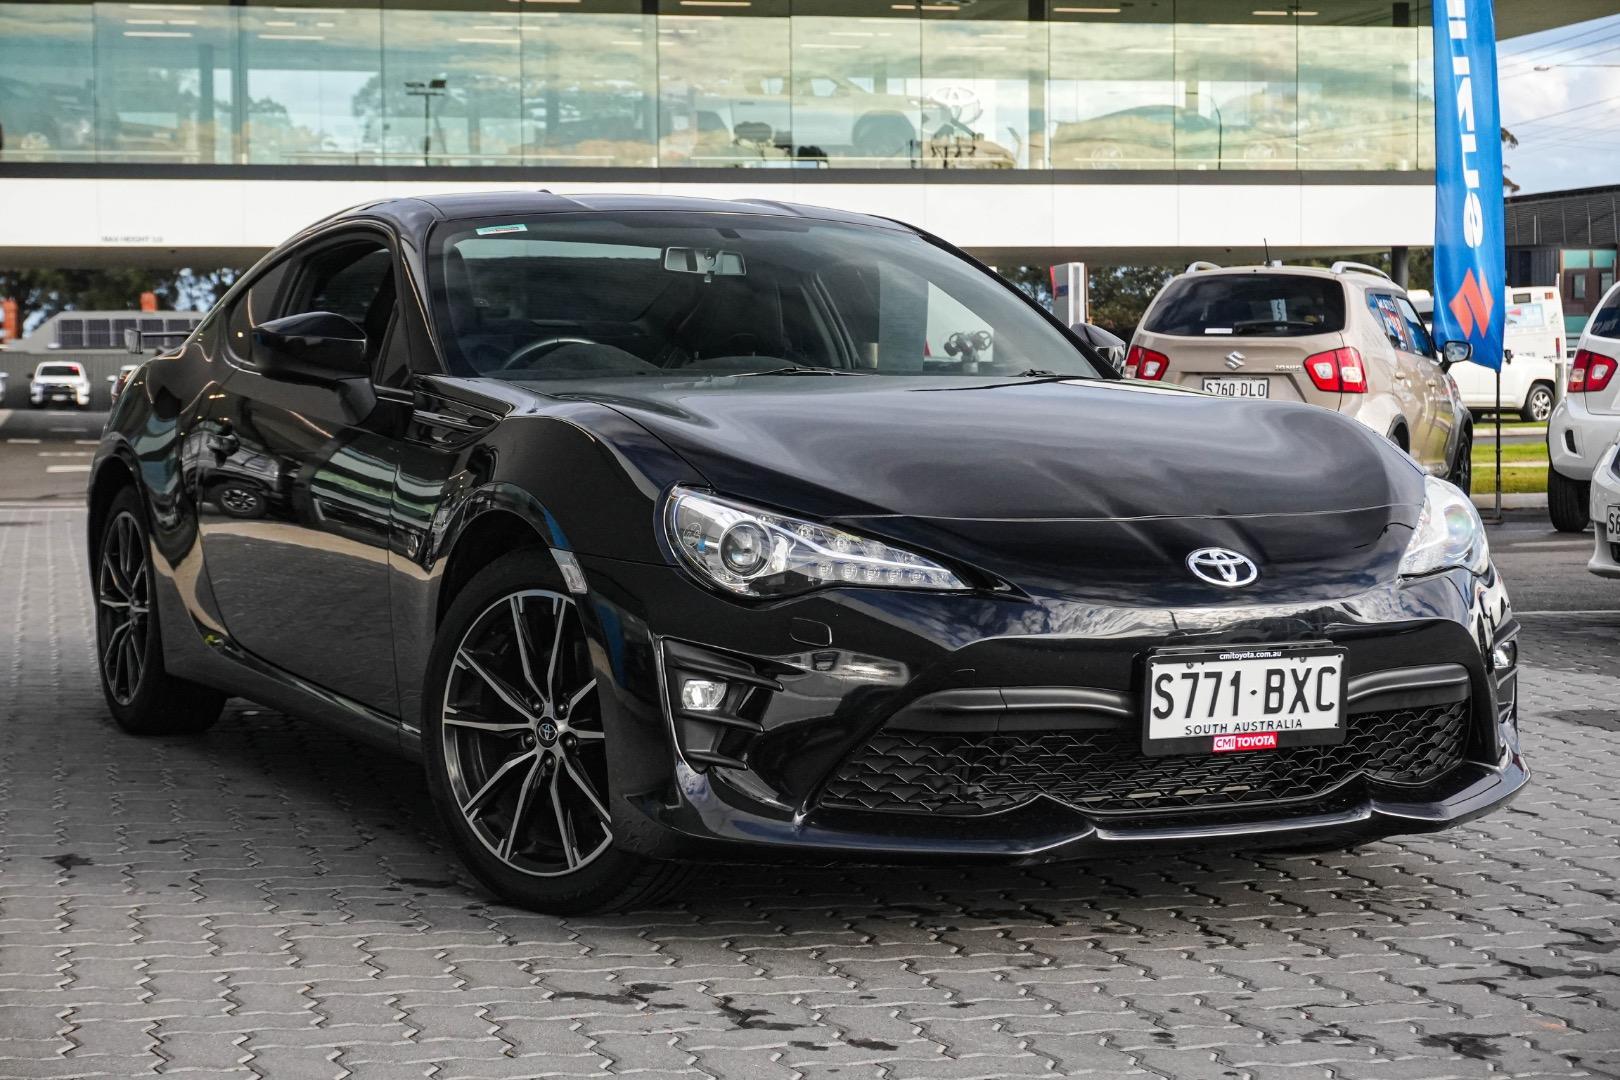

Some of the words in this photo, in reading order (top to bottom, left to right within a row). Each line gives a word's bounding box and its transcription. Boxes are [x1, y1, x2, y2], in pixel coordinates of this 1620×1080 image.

[1219, 650, 1282, 661] cmitoyota.com.au
[1185, 723, 1228, 736] SOUTH
[1234, 718, 1303, 734] AUSTRALIA
[1215, 736, 1235, 749] CMI
[1237, 735, 1277, 747] TOYOTA
